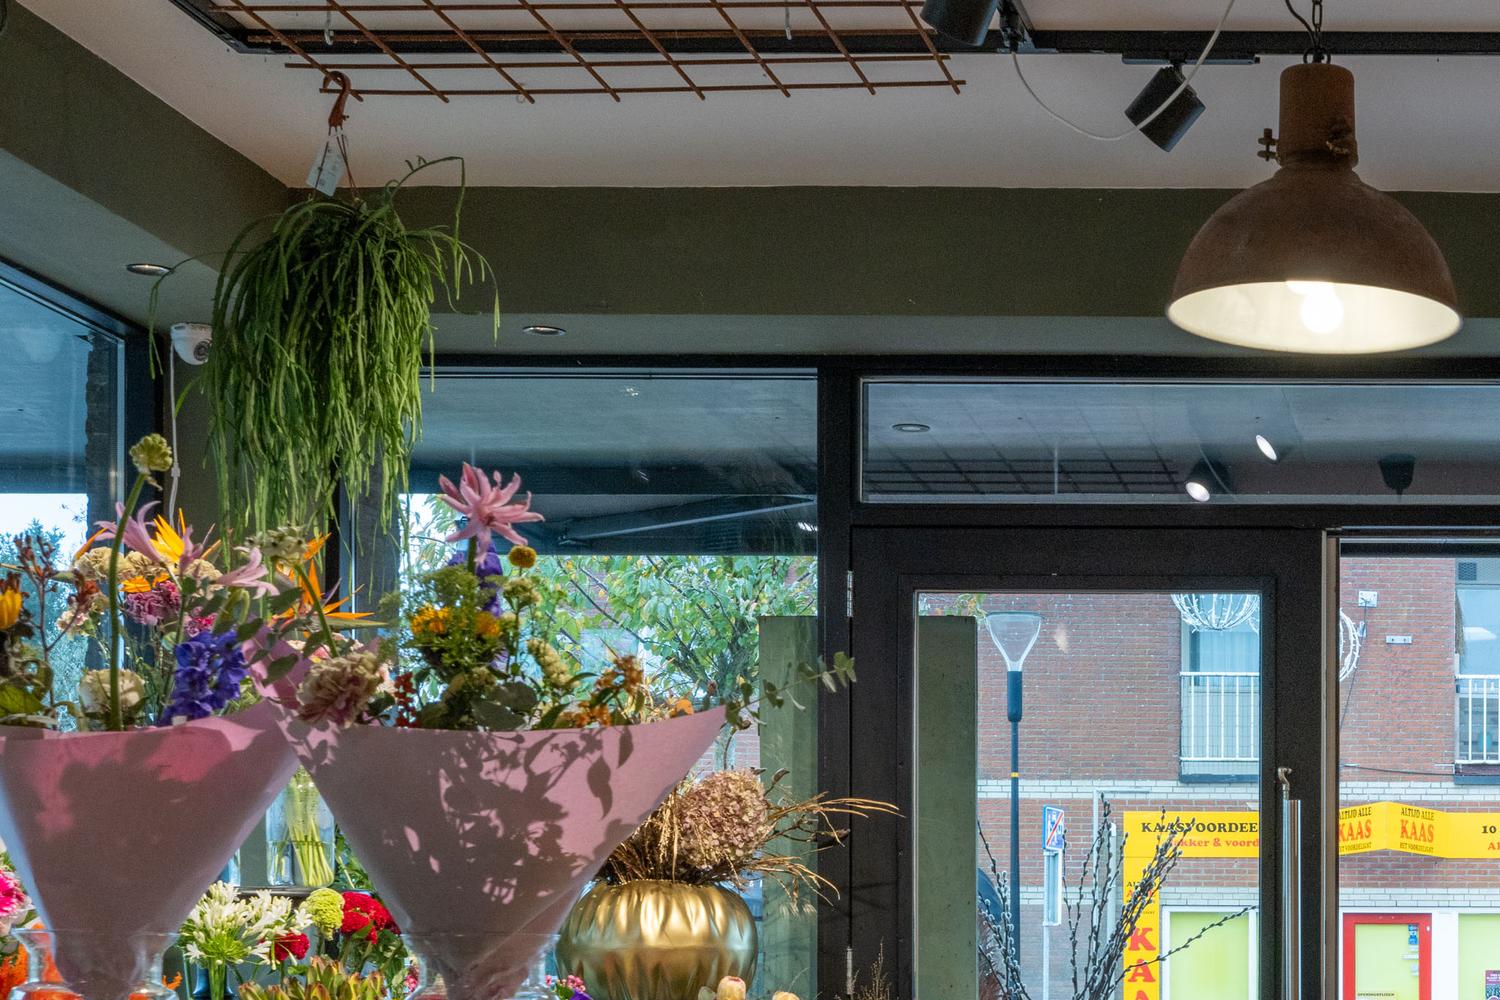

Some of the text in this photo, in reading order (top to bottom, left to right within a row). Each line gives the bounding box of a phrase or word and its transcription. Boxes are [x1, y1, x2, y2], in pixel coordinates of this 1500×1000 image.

[1401, 807, 1435, 820] ALTIJD ALLE
[1339, 819, 1372, 842] KAAS
[1400, 819, 1435, 843] KAAS
[1482, 825, 1497, 834] 10
[1171, 838, 1209, 847] ekker
[1213, 838, 1222, 847] &
